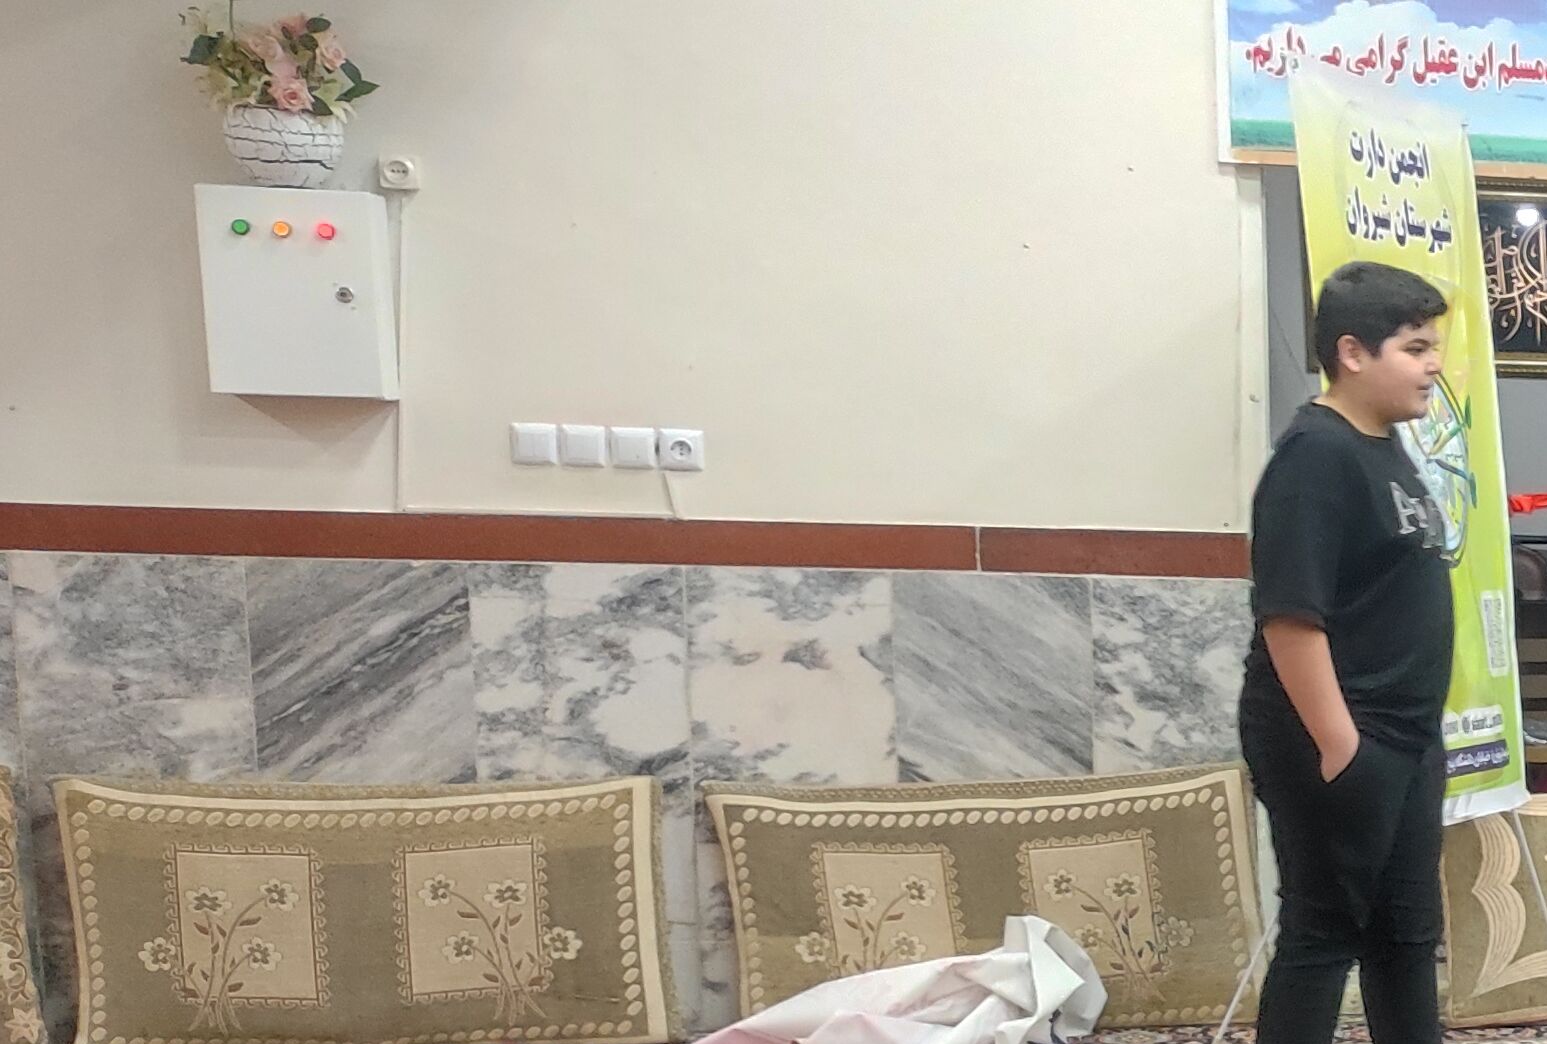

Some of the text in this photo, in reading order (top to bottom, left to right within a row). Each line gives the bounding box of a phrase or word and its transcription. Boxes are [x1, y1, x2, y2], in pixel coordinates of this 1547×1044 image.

[1347, 32, 1410, 84] گرامی
[1413, 34, 1459, 84] عقیل
[1463, 41, 1494, 89] ابن
[1498, 42, 1544, 93] مسلم
[1350, 128, 1430, 188] انجمن دارت
[1346, 186, 1452, 253] شهرستان شیروان
